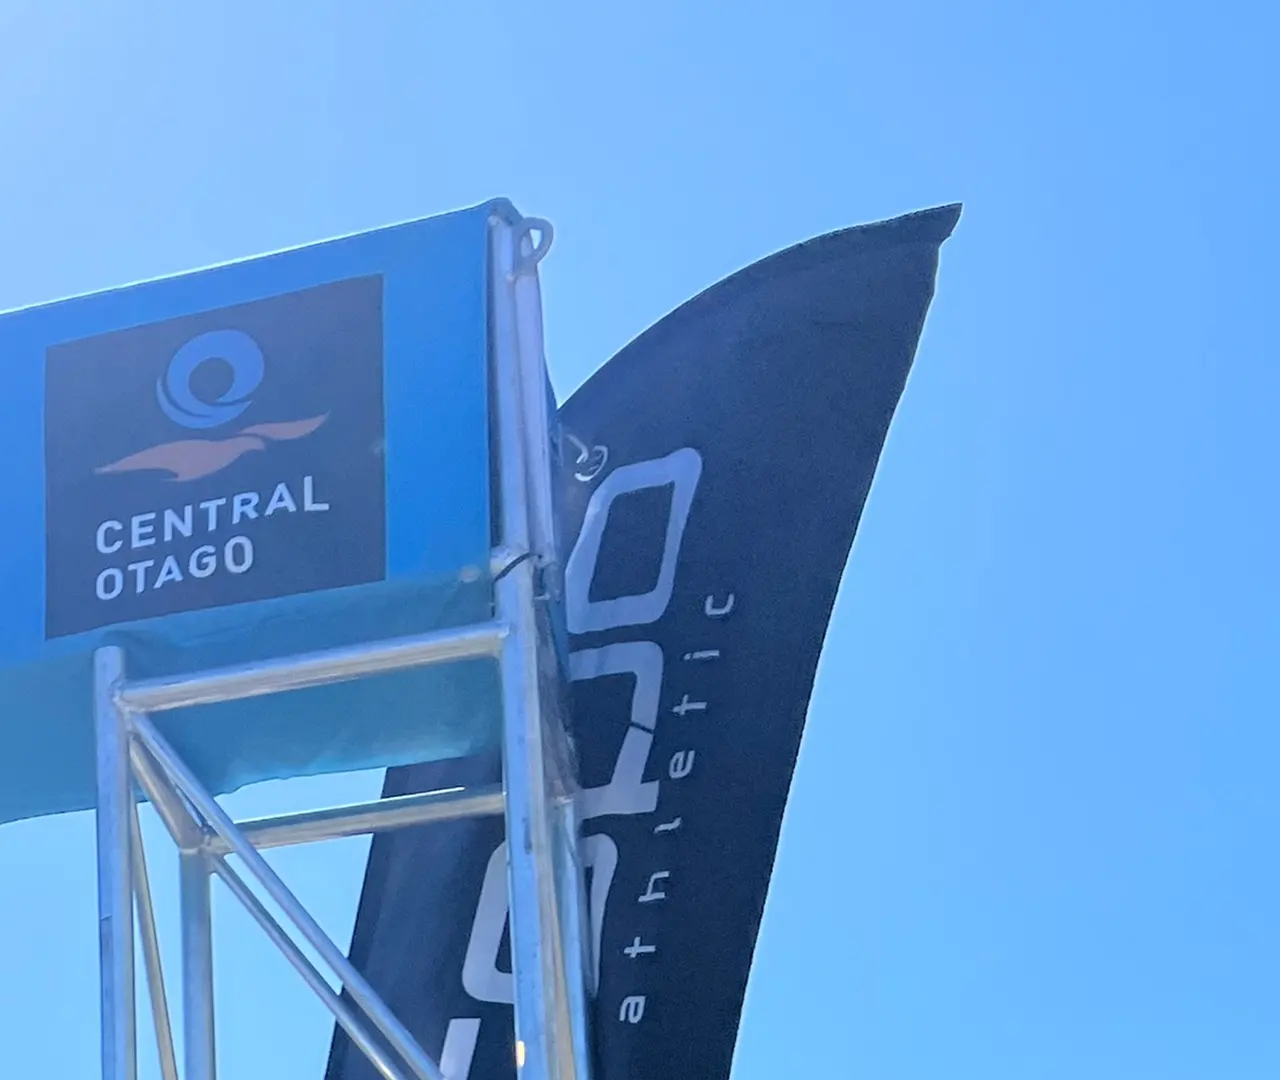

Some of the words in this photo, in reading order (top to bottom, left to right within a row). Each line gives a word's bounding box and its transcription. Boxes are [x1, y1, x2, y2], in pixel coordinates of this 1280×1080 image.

[95, 475, 330, 554] CENTRAL
[95, 535, 255, 601] OTAGO
[618, 590, 737, 1026] athletic
